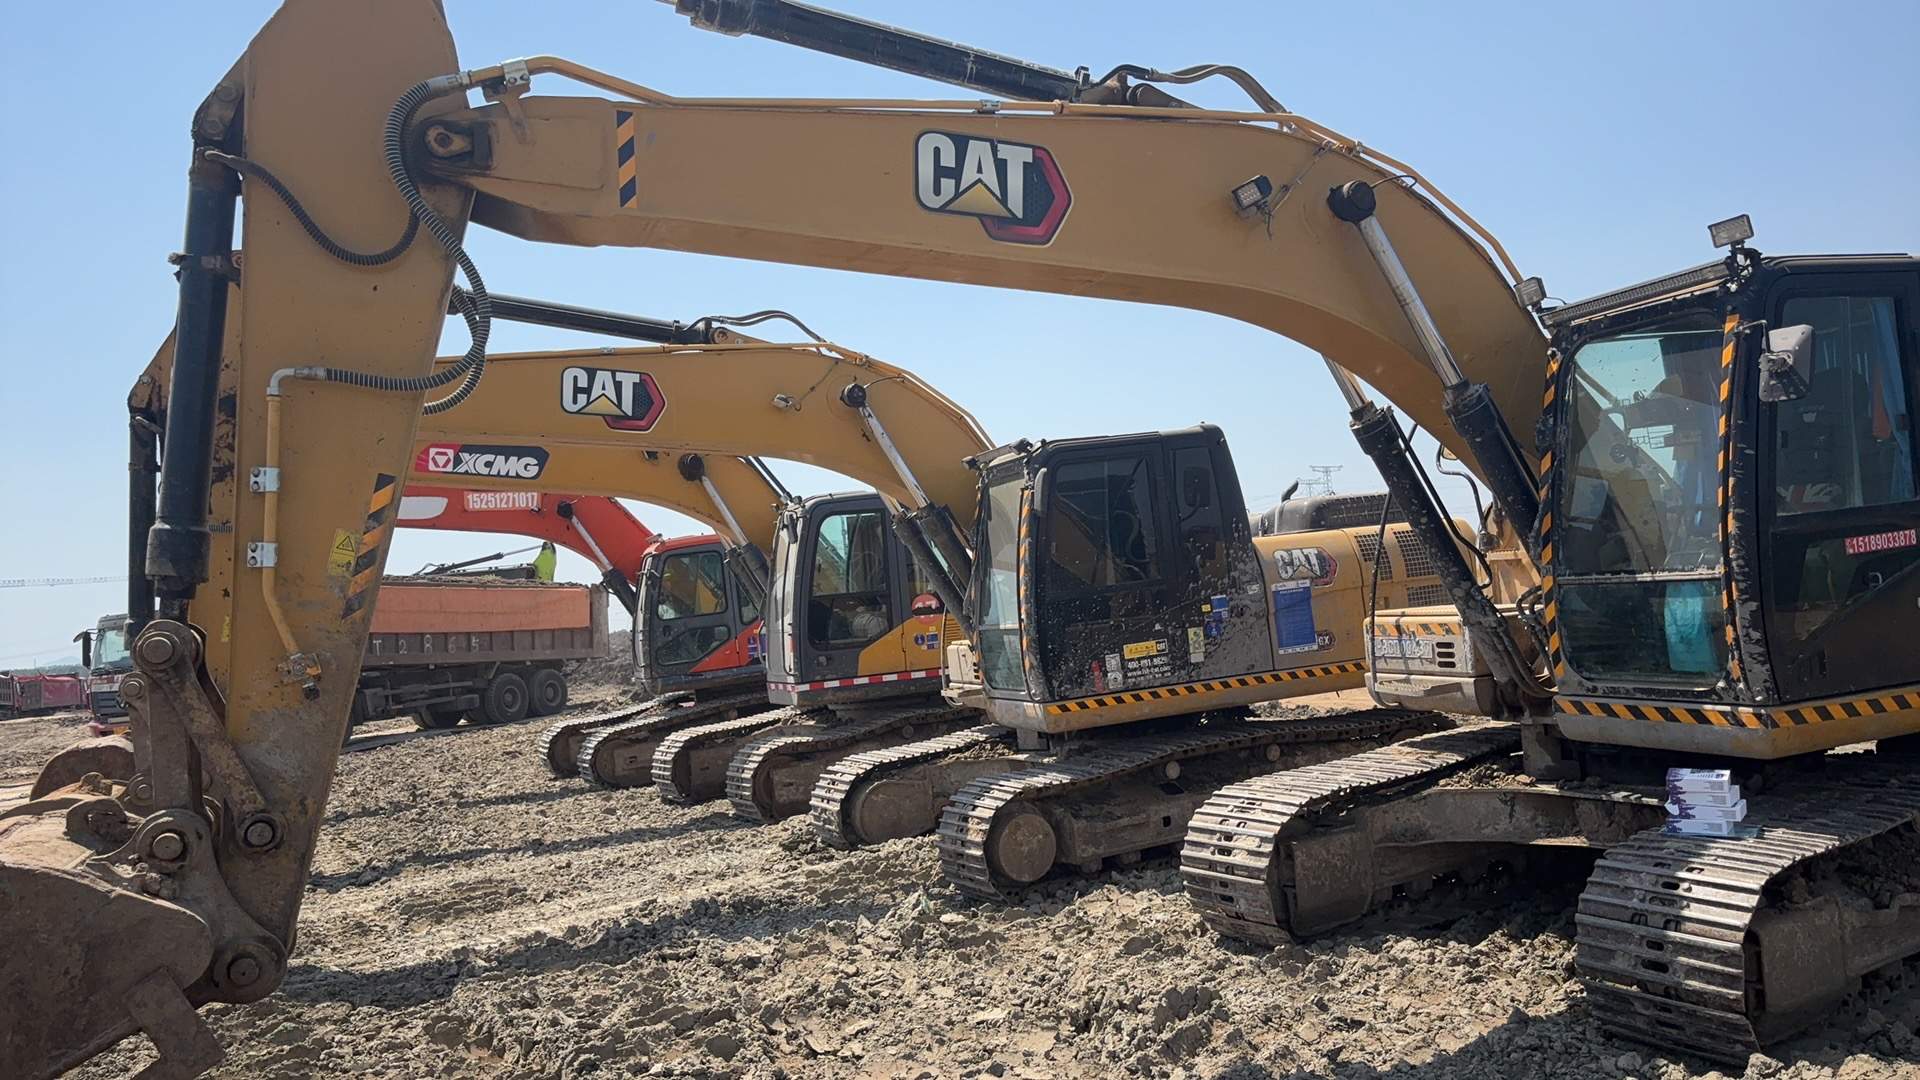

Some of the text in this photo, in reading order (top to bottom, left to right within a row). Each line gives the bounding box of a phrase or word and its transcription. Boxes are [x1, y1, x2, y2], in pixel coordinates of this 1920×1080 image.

[918, 133, 1033, 219] CAT
[562, 367, 641, 417] CAT
[453, 452, 539, 478] XCMG
[467, 491, 538, 509] 15251271017
[1274, 548, 1320, 580] CAT
